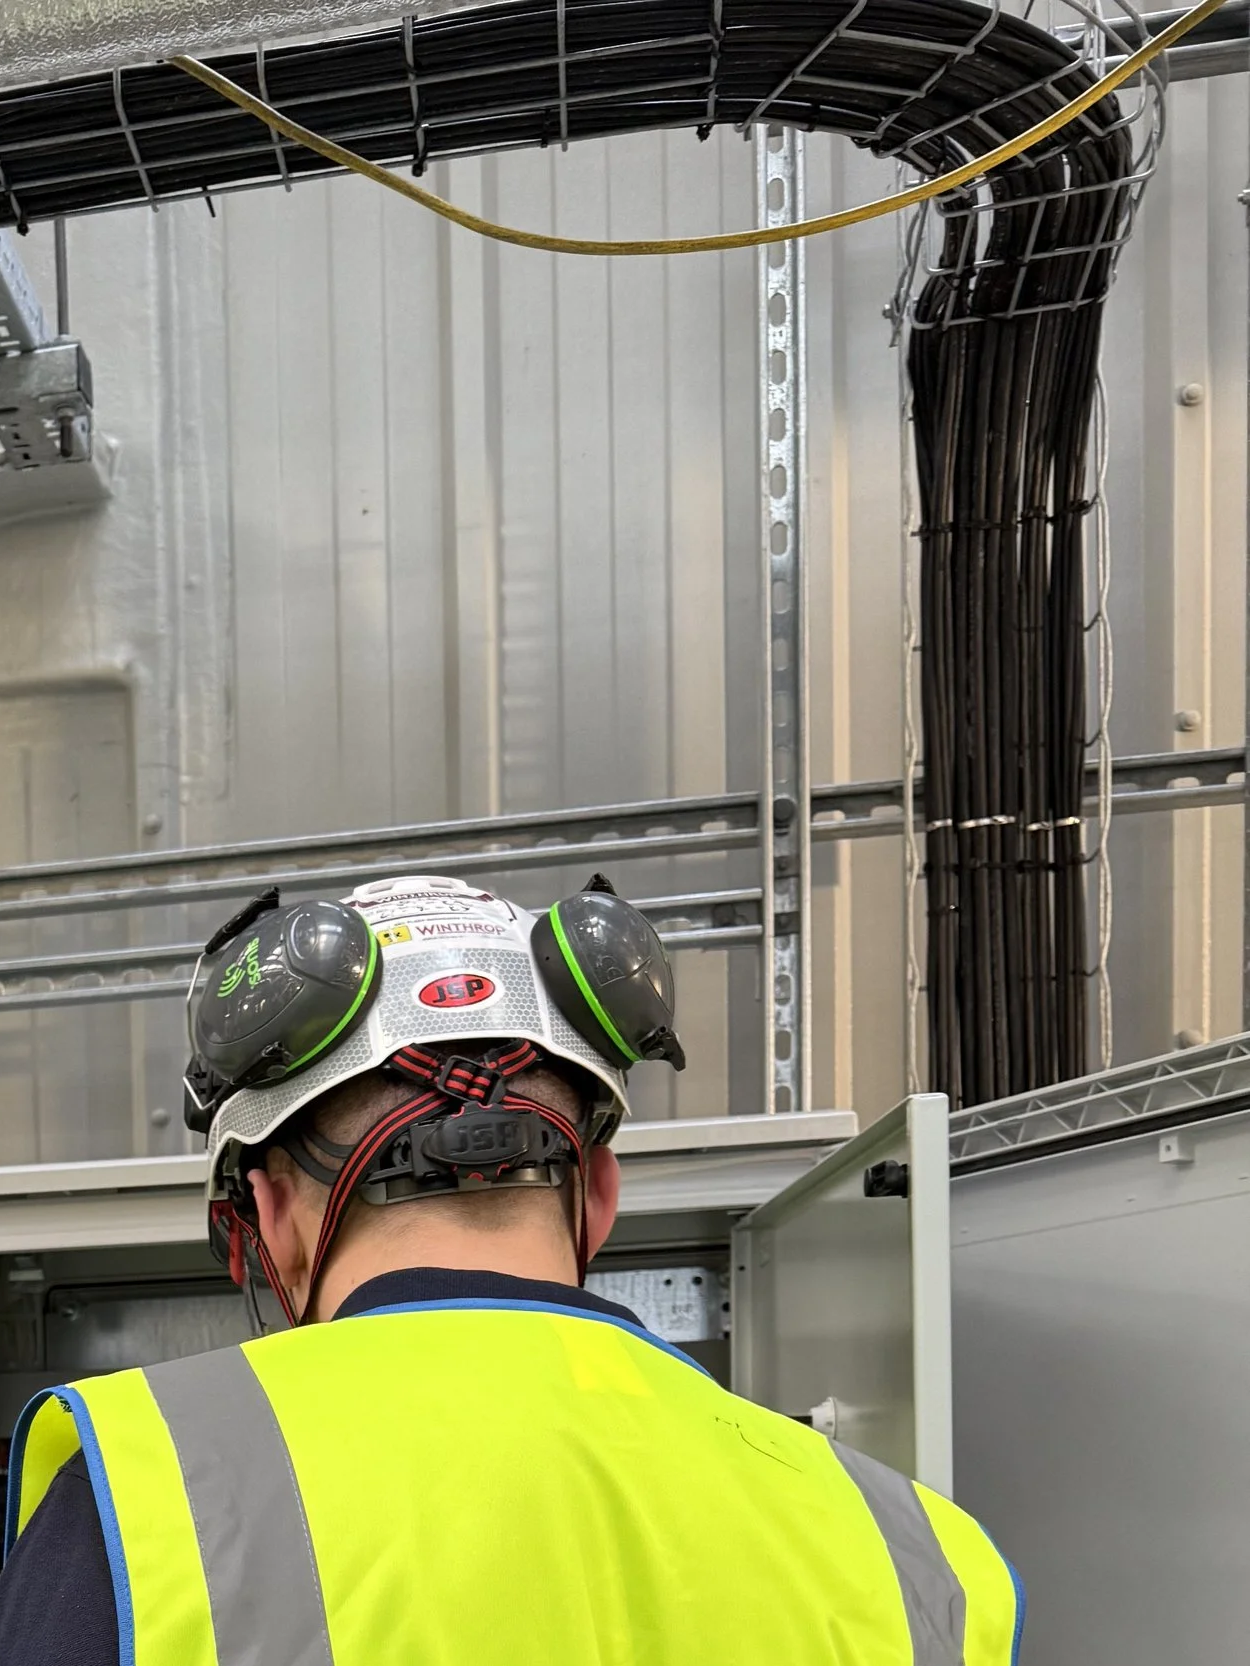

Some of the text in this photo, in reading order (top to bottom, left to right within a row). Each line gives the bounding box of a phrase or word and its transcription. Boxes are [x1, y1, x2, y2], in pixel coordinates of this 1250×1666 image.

[416, 923, 505, 936] WINTHROP
[433, 979, 484, 1003] JSP
[450, 1121, 519, 1156] JSP
